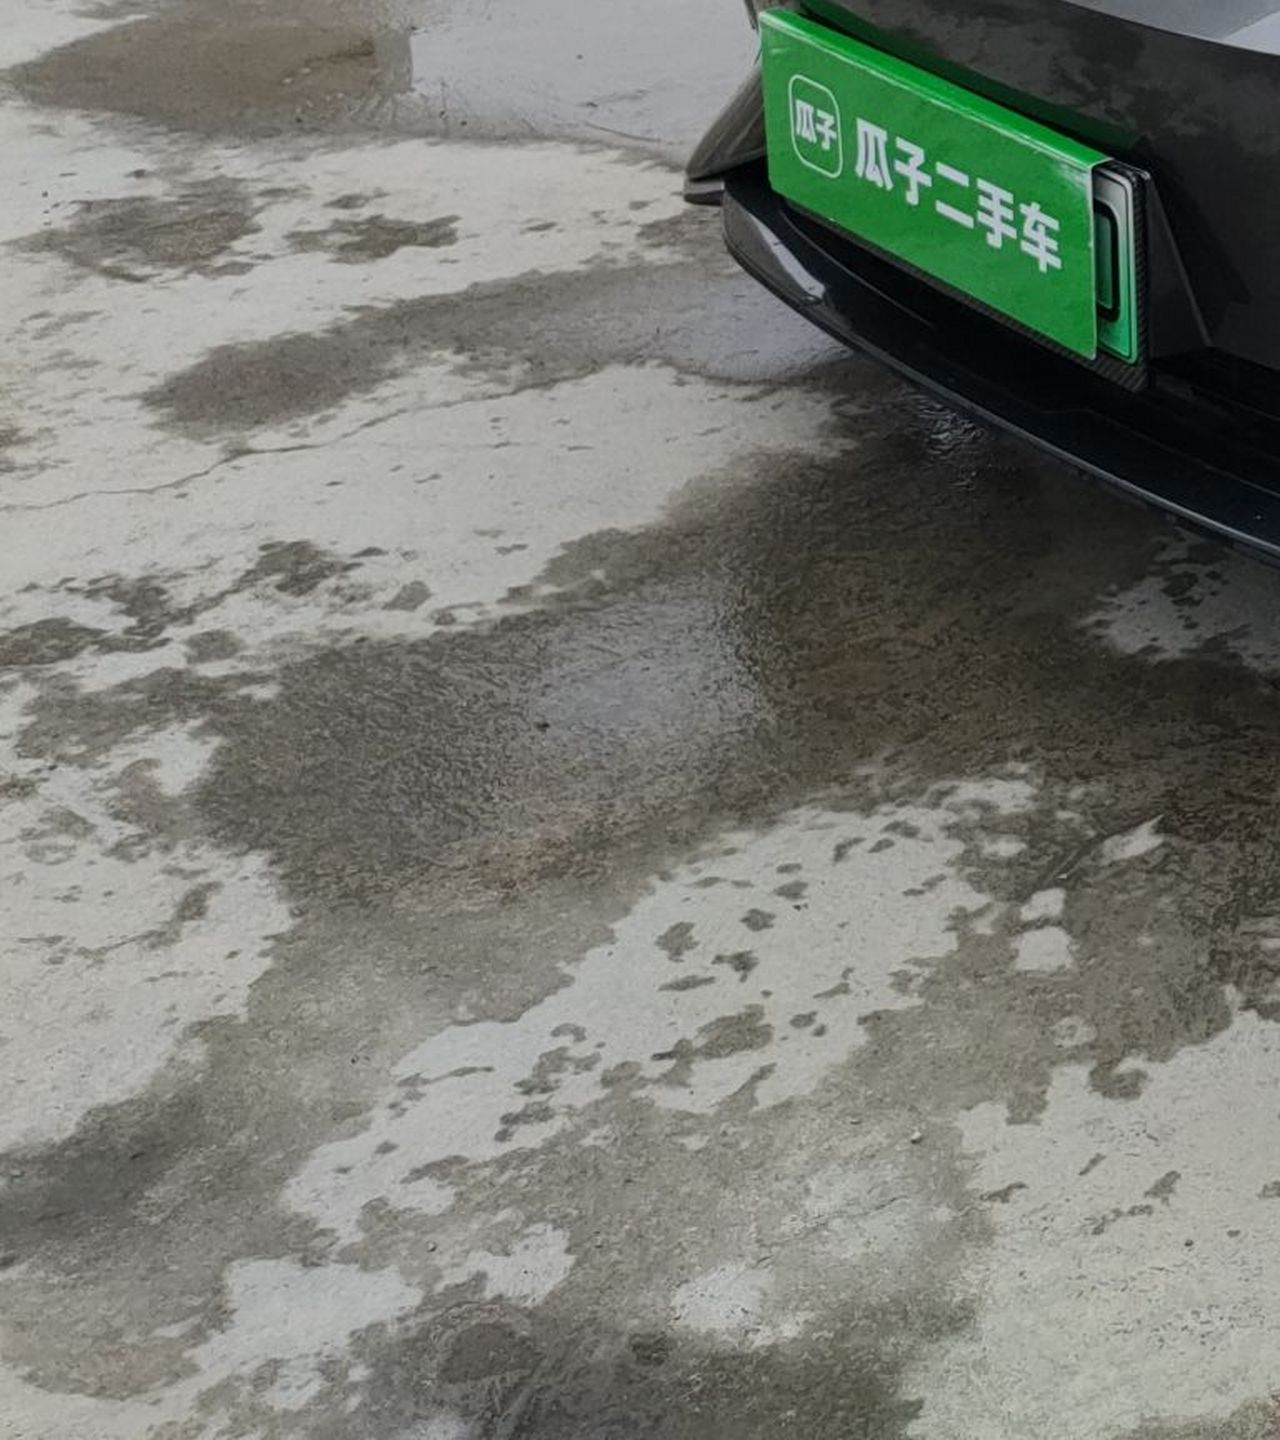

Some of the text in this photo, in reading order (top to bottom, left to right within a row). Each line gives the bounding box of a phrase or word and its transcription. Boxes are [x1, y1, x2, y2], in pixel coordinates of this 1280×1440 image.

[794, 99, 1062, 273] 瓜子 瓜子二手车
